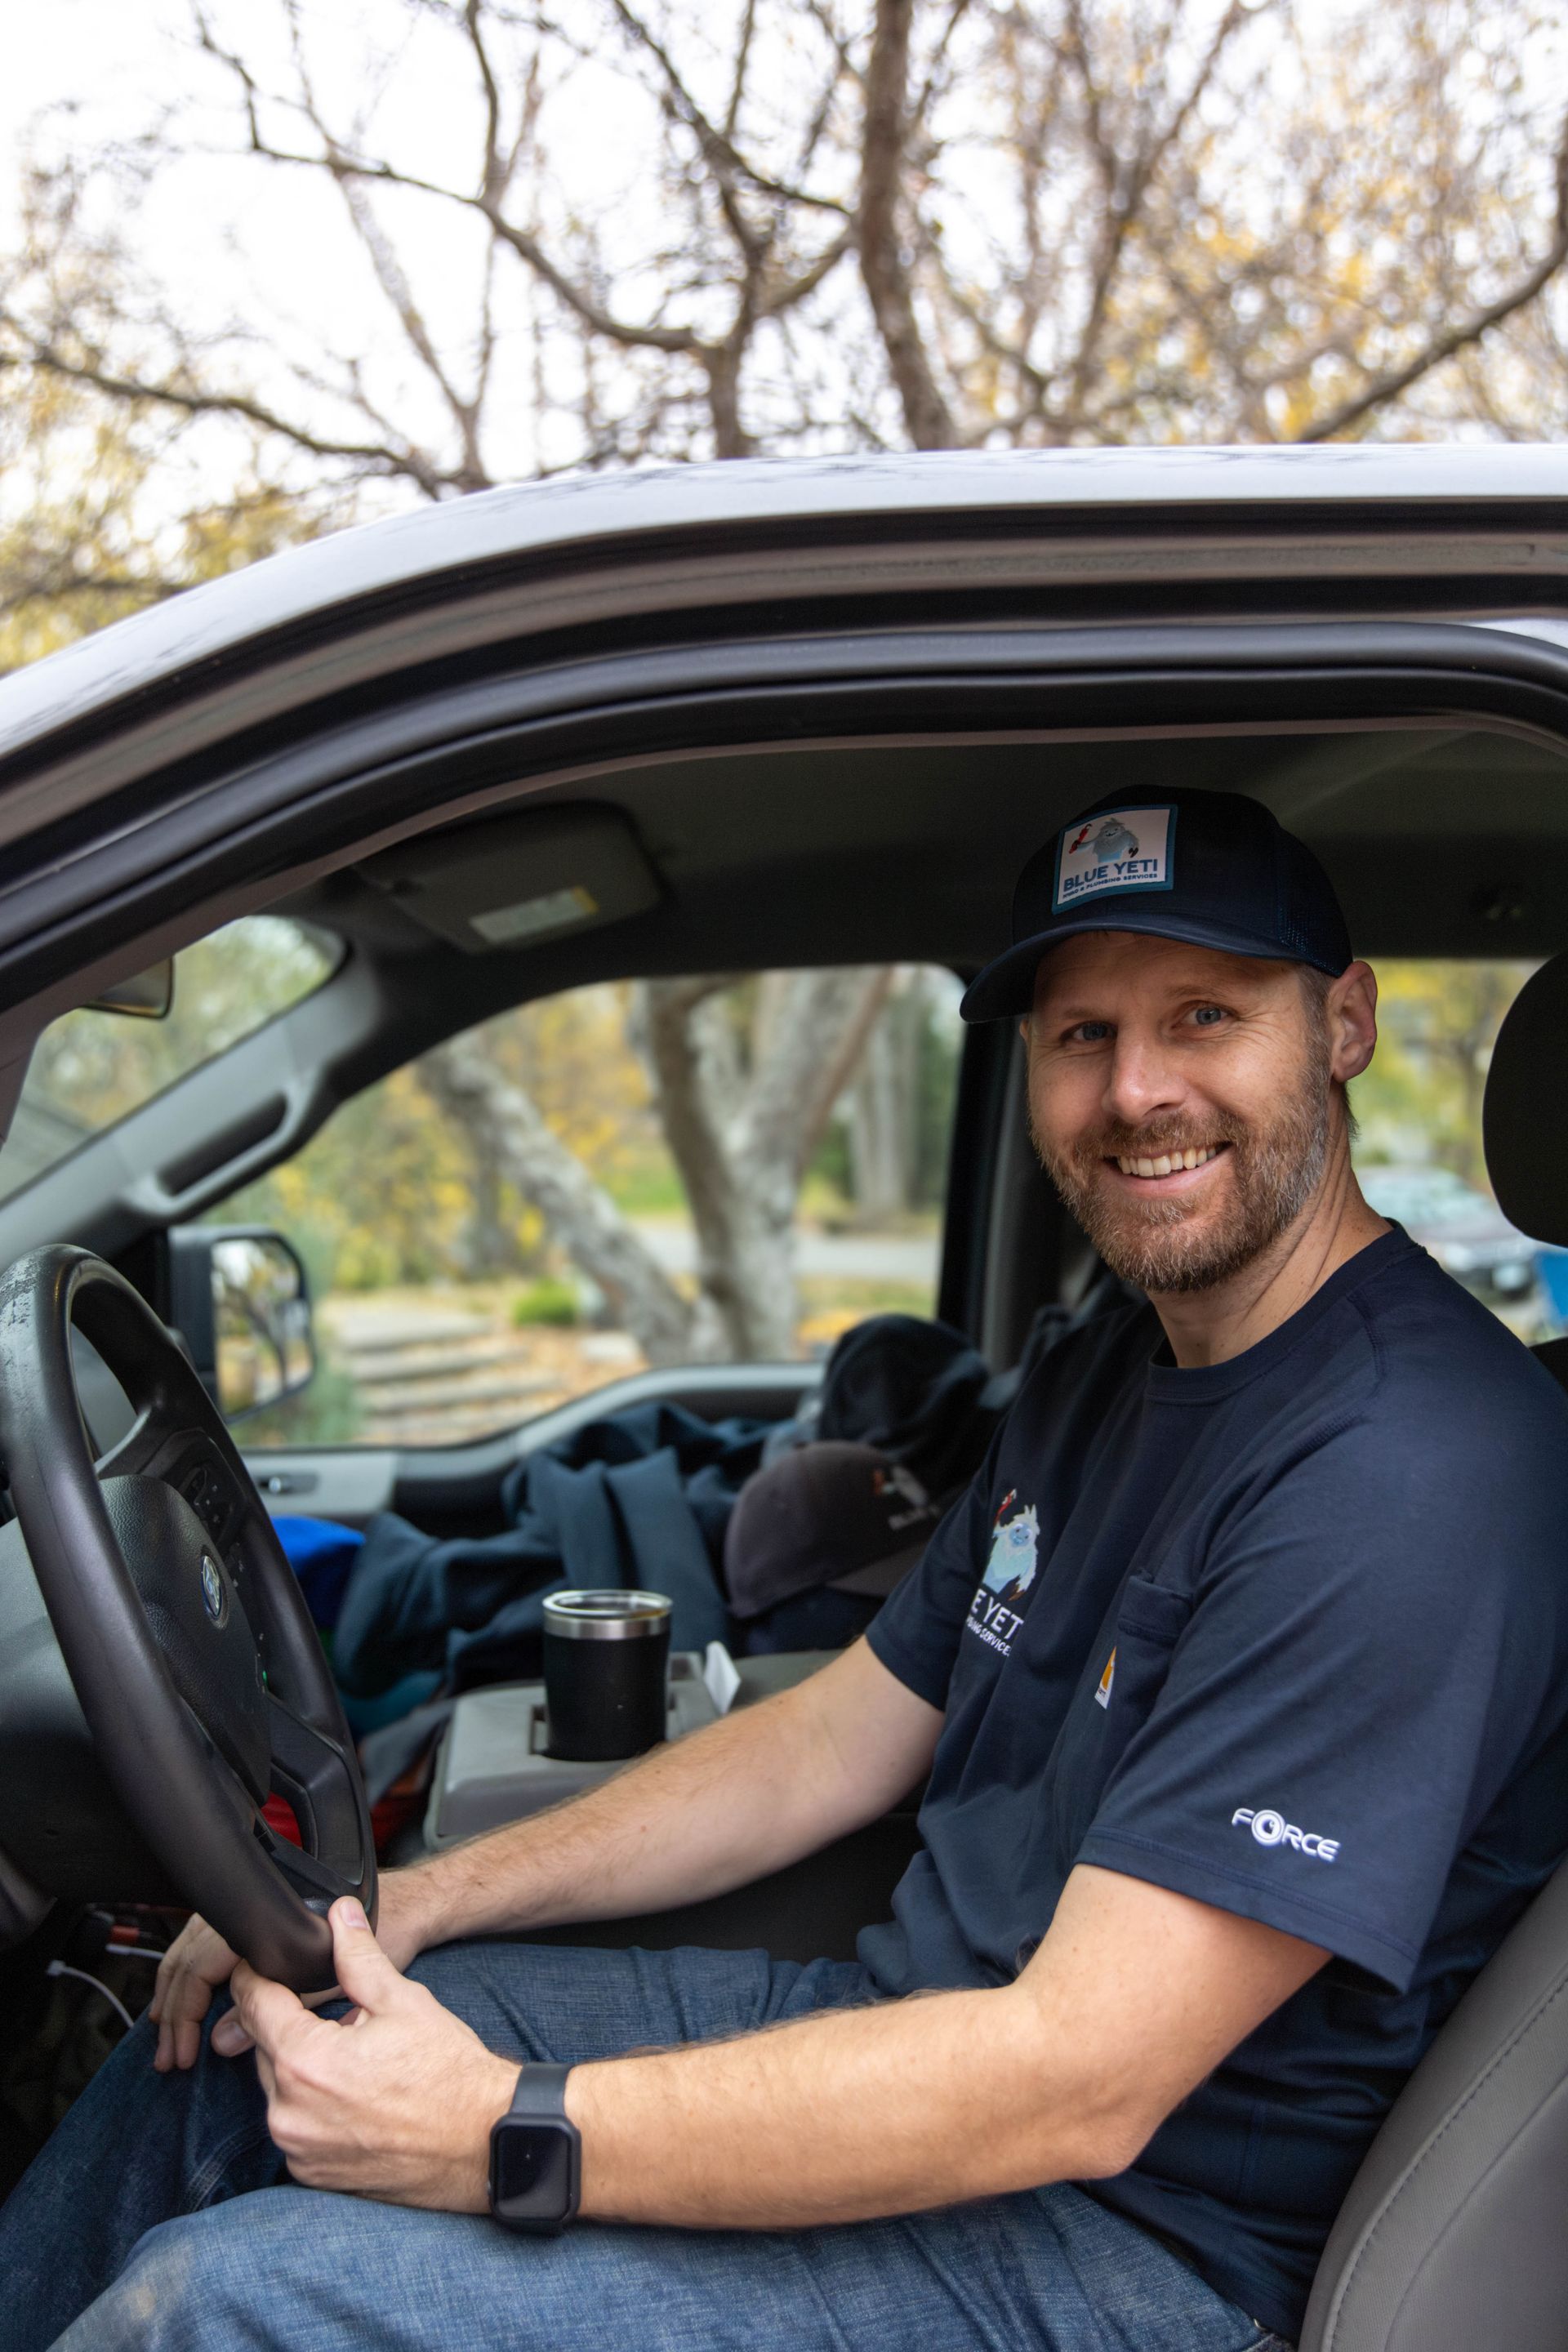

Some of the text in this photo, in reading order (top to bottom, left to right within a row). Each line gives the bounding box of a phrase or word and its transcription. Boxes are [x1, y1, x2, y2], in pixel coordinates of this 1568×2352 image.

[1063, 859, 1158, 892] BLUE YETI
[1085, 877, 1121, 889] PLUMBING
[1123, 873, 1158, 881] SERVICES
[982, 1596, 1025, 1640] YET
[979, 1628, 1013, 1658] SERVICE
[1232, 1807, 1342, 1863] FORCE
